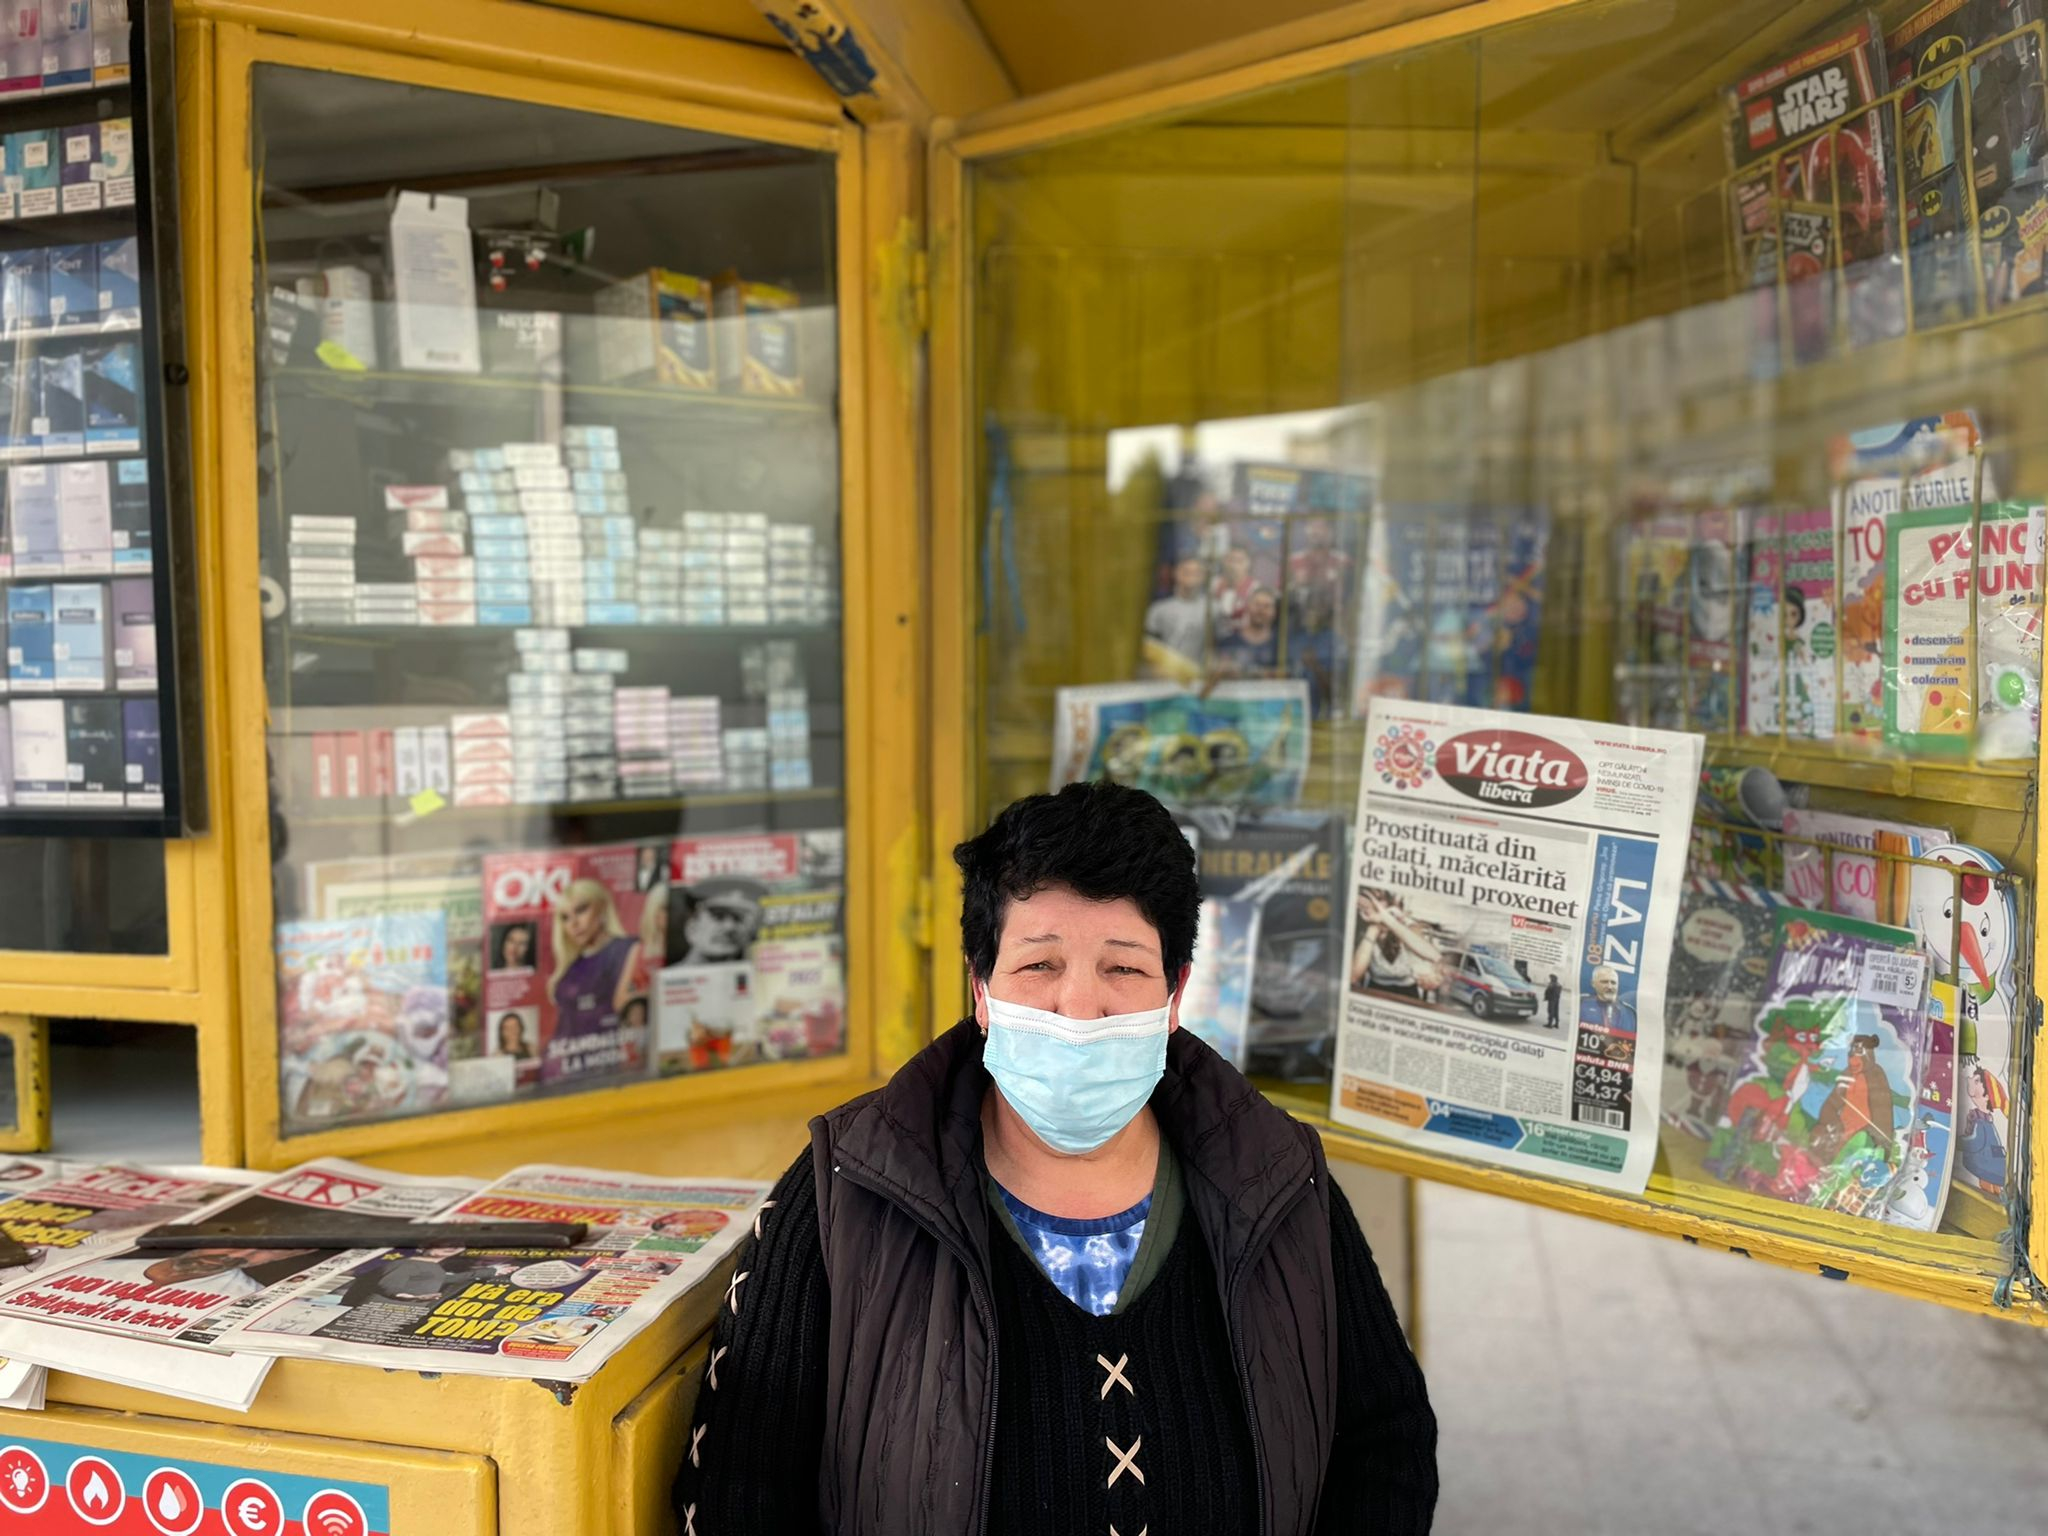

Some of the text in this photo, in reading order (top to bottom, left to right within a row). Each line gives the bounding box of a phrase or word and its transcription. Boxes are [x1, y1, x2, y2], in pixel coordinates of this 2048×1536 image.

[1778, 67, 1848, 113] STAR
[1779, 88, 1849, 136] WARS
[1851, 477, 1971, 516] ANOTIPURILE
[1848, 517, 1886, 562] TO
[1928, 522, 2028, 566] PUNC
[1622, 781, 1632, 789] DE
[1633, 782, 1664, 793] COVID-19
[1365, 815, 1537, 861] Prostituată din
[1439, 853, 1567, 891] măcelărită
[1360, 861, 1578, 919] de iubitul proxenet
[1602, 877, 1648, 975] LA ZI
[1378, 1021, 1392, 1033] de
[1393, 1026, 1443, 1046] vaccinare
[1444, 1038, 1507, 1061] anti-COVID
[1420, 1021, 1450, 1036] peste
[1453, 1028, 1509, 1049] municipiul
[1579, 1022, 1610, 1034] meteo
[1575, 1064, 1622, 1085] €4,94
[1576, 1053, 1630, 1072] valuta BNR
[1430, 1101, 1451, 1118] 04
[1526, 1121, 1545, 1137] 16
[43, 1275, 113, 1294] ANDI
[460, 1282, 565, 1306] Vă era
[100, 1306, 132, 1322] de
[432, 1299, 543, 1323] dor de
[415, 1316, 520, 1340] TONI?
